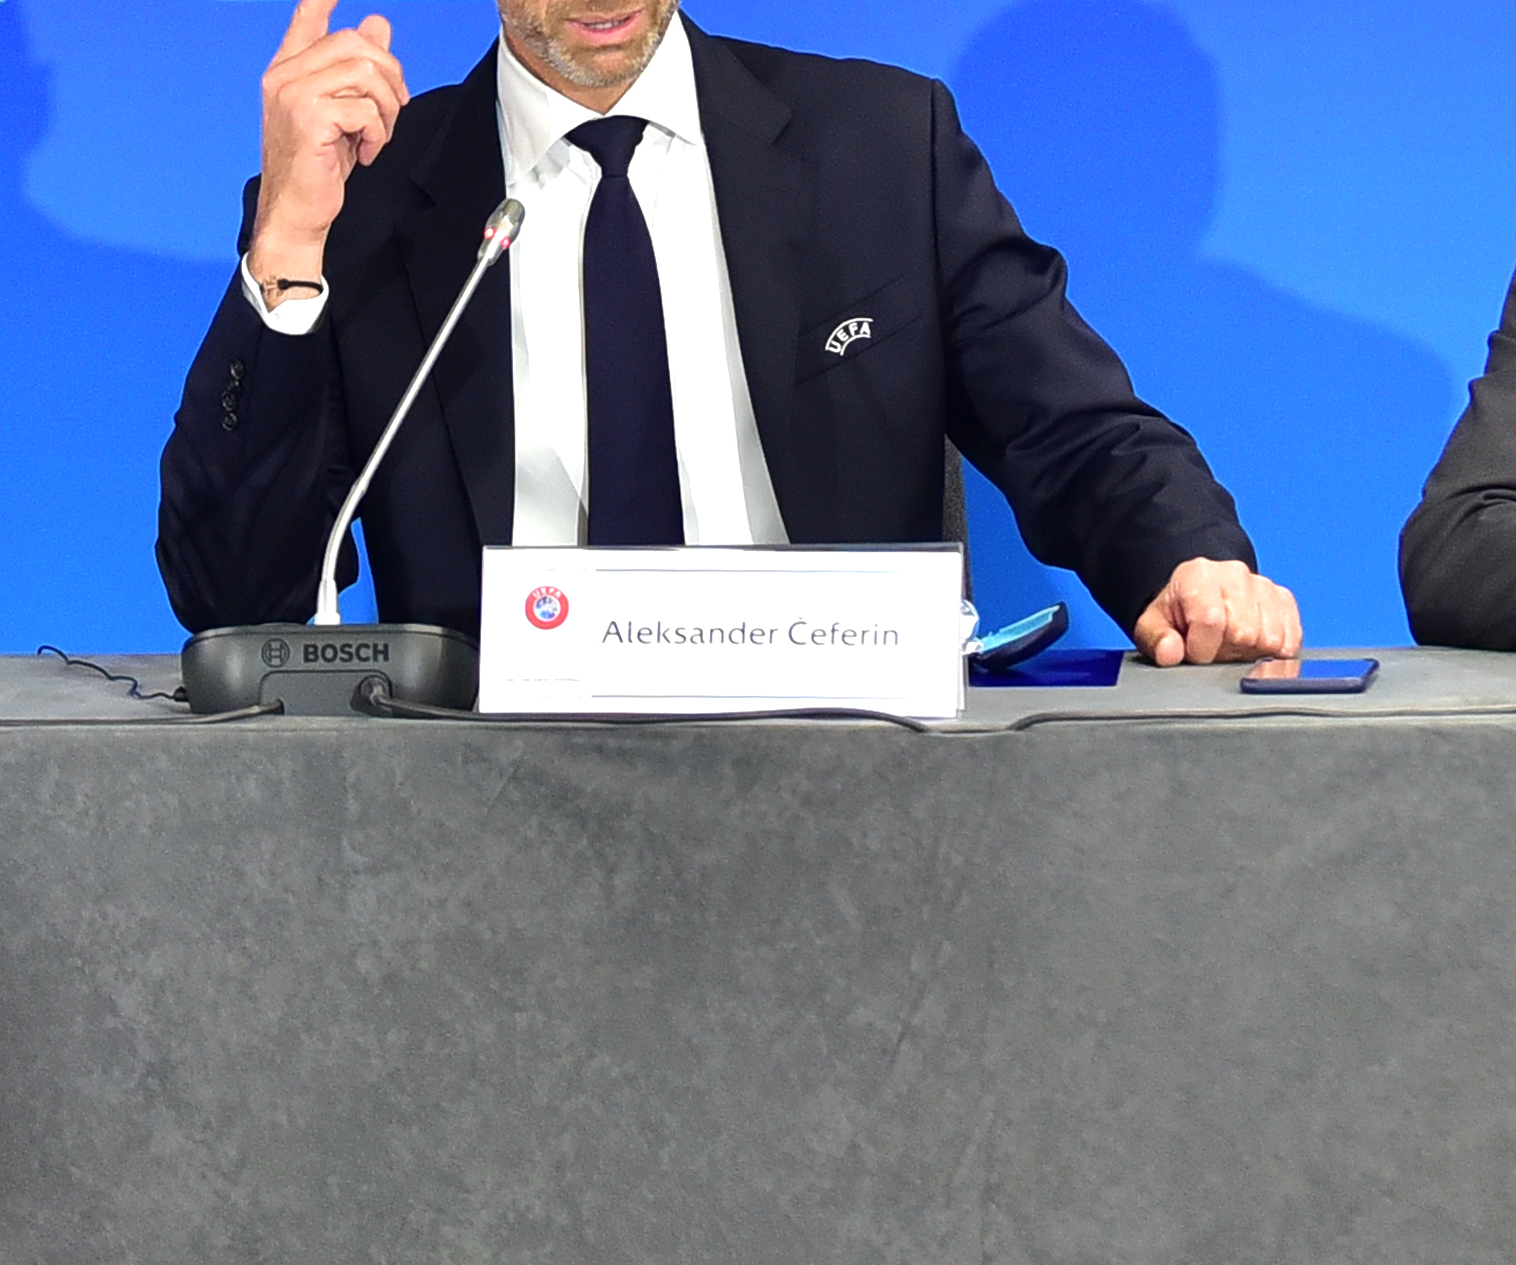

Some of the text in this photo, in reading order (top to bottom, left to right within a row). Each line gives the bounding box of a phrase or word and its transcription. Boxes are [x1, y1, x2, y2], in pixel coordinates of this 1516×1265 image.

[828, 321, 871, 354] UEFA
[601, 620, 779, 646] Aleksander
[302, 641, 391, 665] BOSCH
